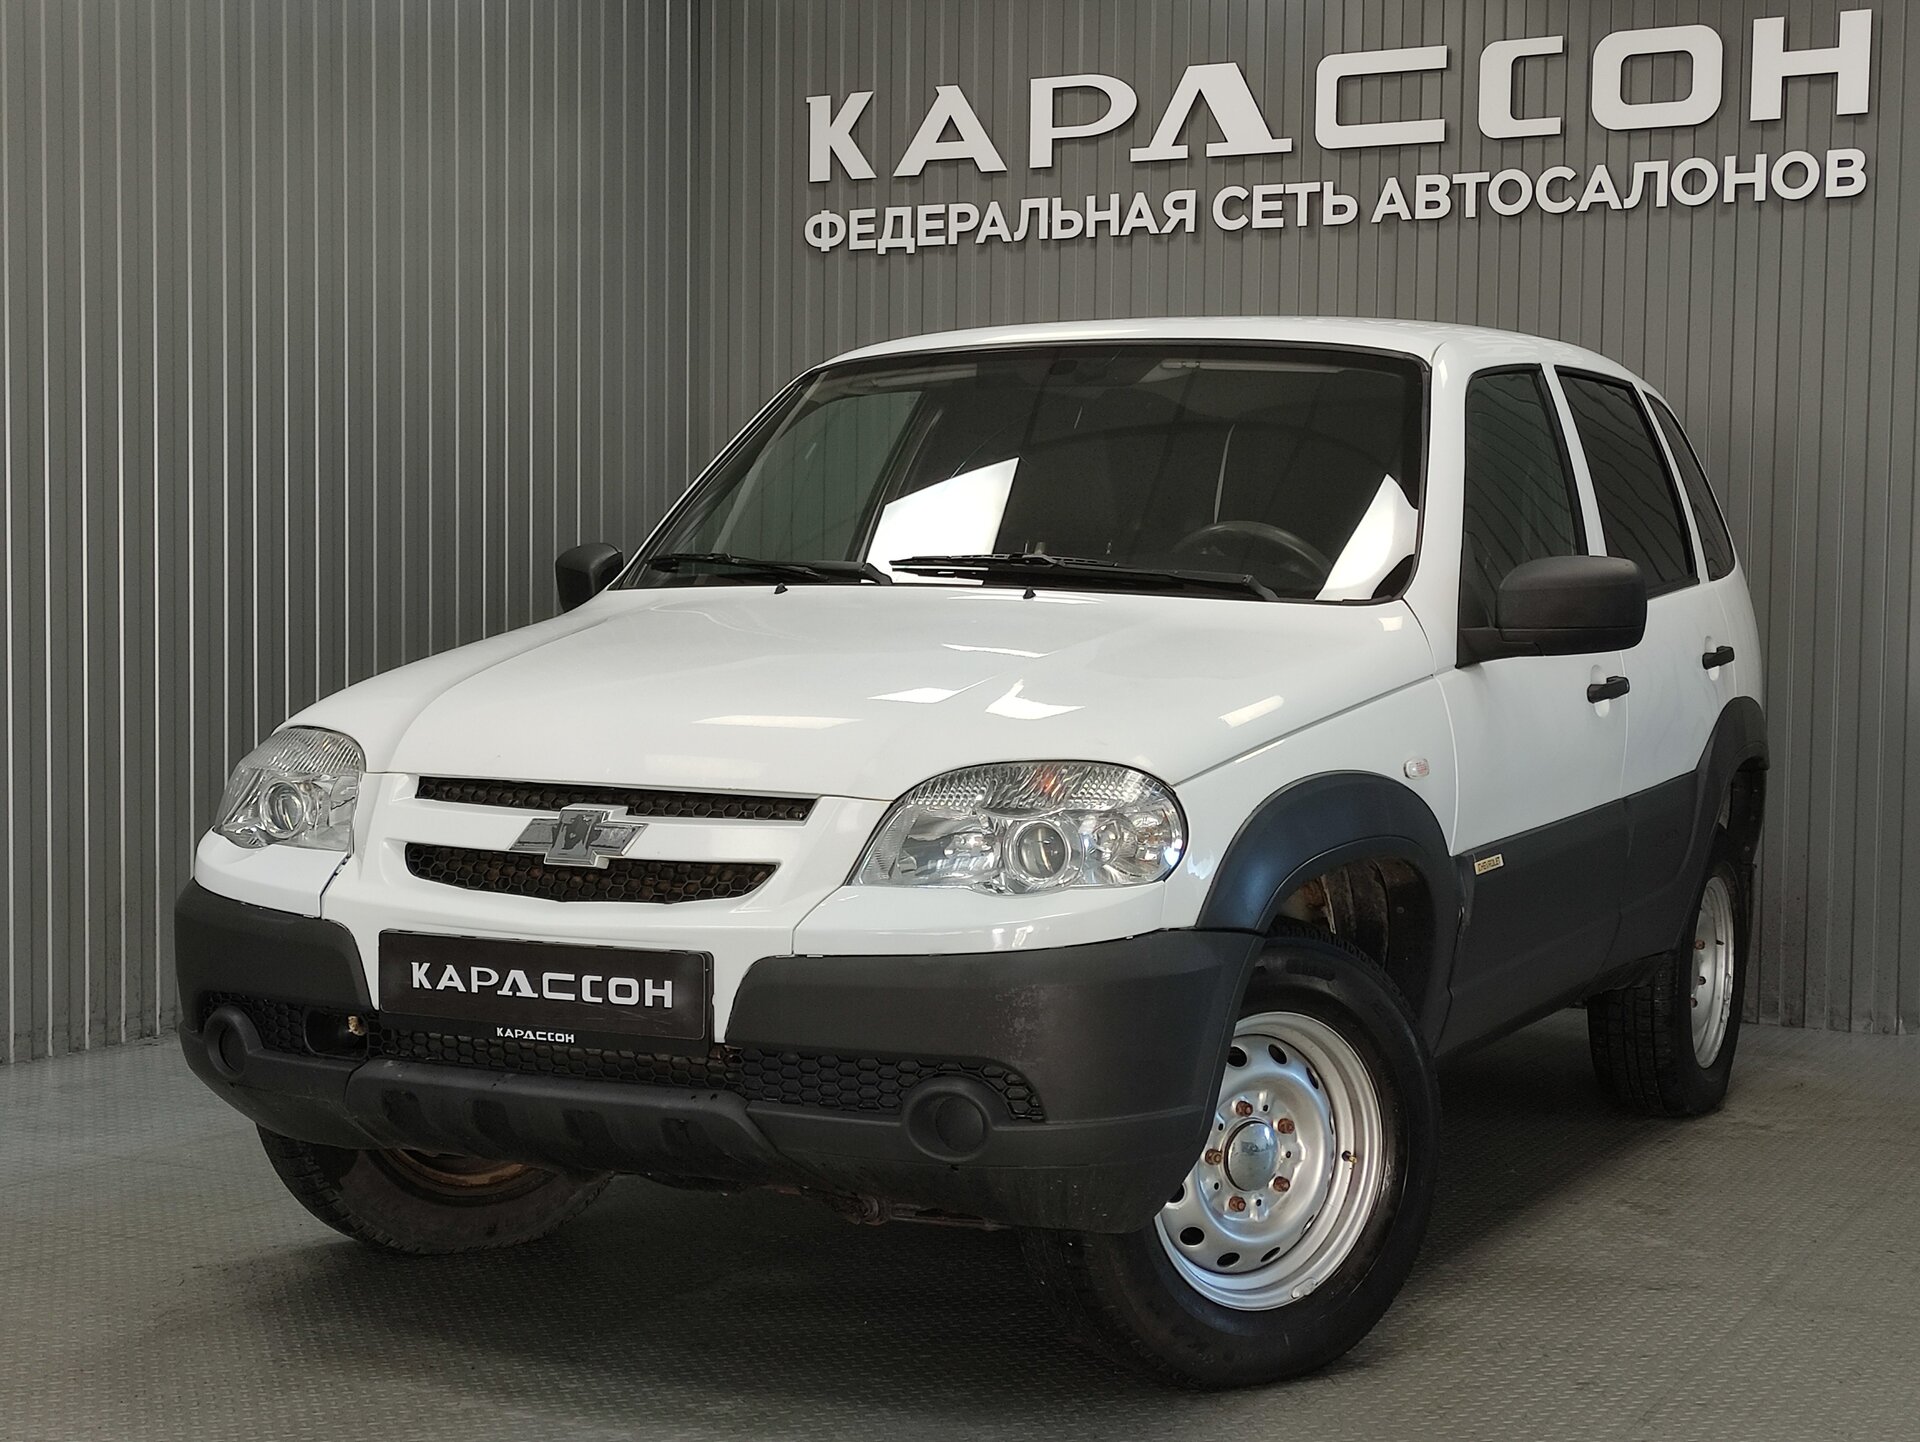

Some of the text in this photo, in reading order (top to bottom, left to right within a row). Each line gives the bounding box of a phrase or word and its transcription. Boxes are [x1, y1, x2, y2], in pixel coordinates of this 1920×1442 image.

[806, 8, 1873, 182] КАРАССОН
[804, 148, 1867, 255] ФЕДЕРАЛЬНАЯ СЕТЬ АВТОСАЛОНОВ
[410, 961, 673, 1009] КАРАССОН
